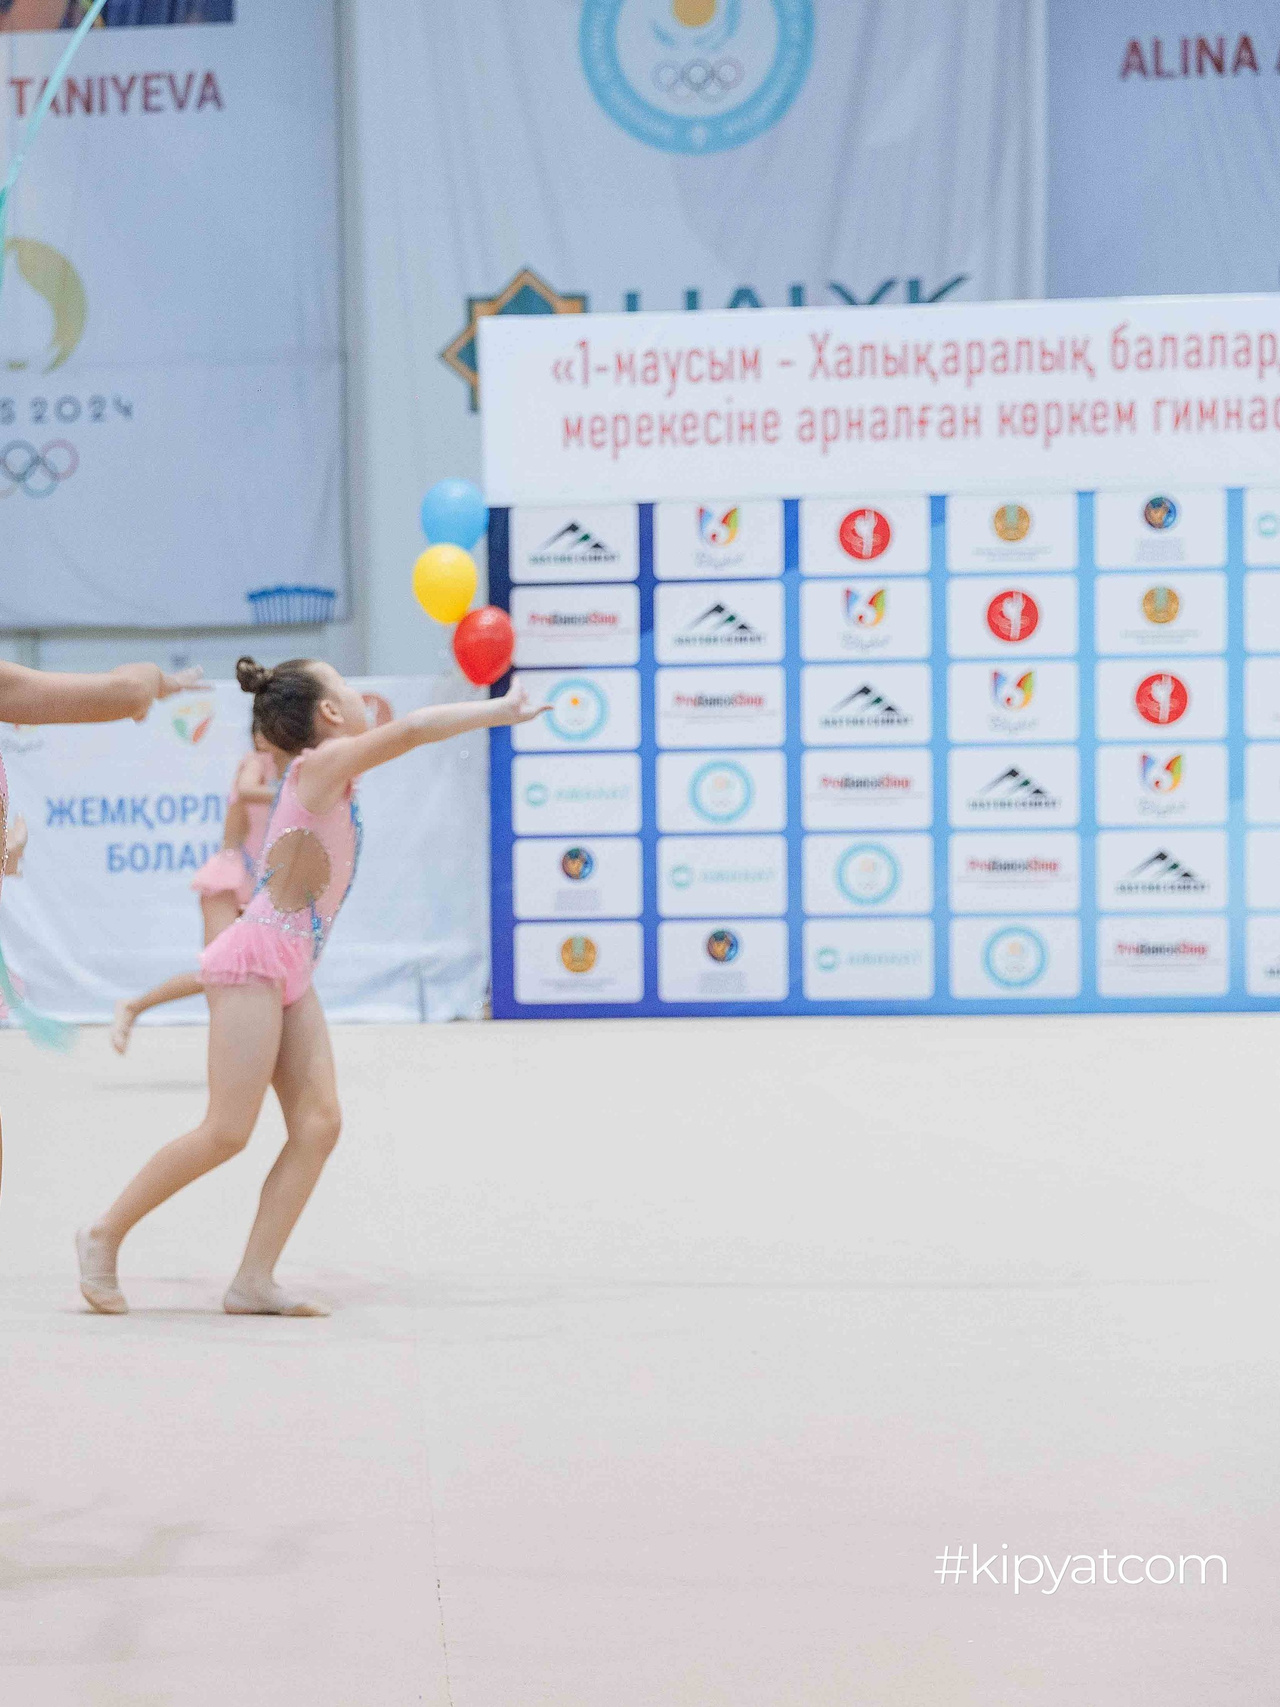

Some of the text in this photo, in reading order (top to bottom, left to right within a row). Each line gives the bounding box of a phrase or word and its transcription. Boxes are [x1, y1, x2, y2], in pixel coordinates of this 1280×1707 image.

[1120, 33, 1260, 80] ALINA
[809, 330, 1096, 389] Халықаралық
[1110, 321, 1280, 381] балалар
[30, 393, 134, 425] 2024
[563, 395, 780, 460] мерекесіне
[797, 403, 981, 456] арналған
[998, 398, 1137, 450] көркем
[46, 792, 224, 831] ЖЕМҚОРЛ
